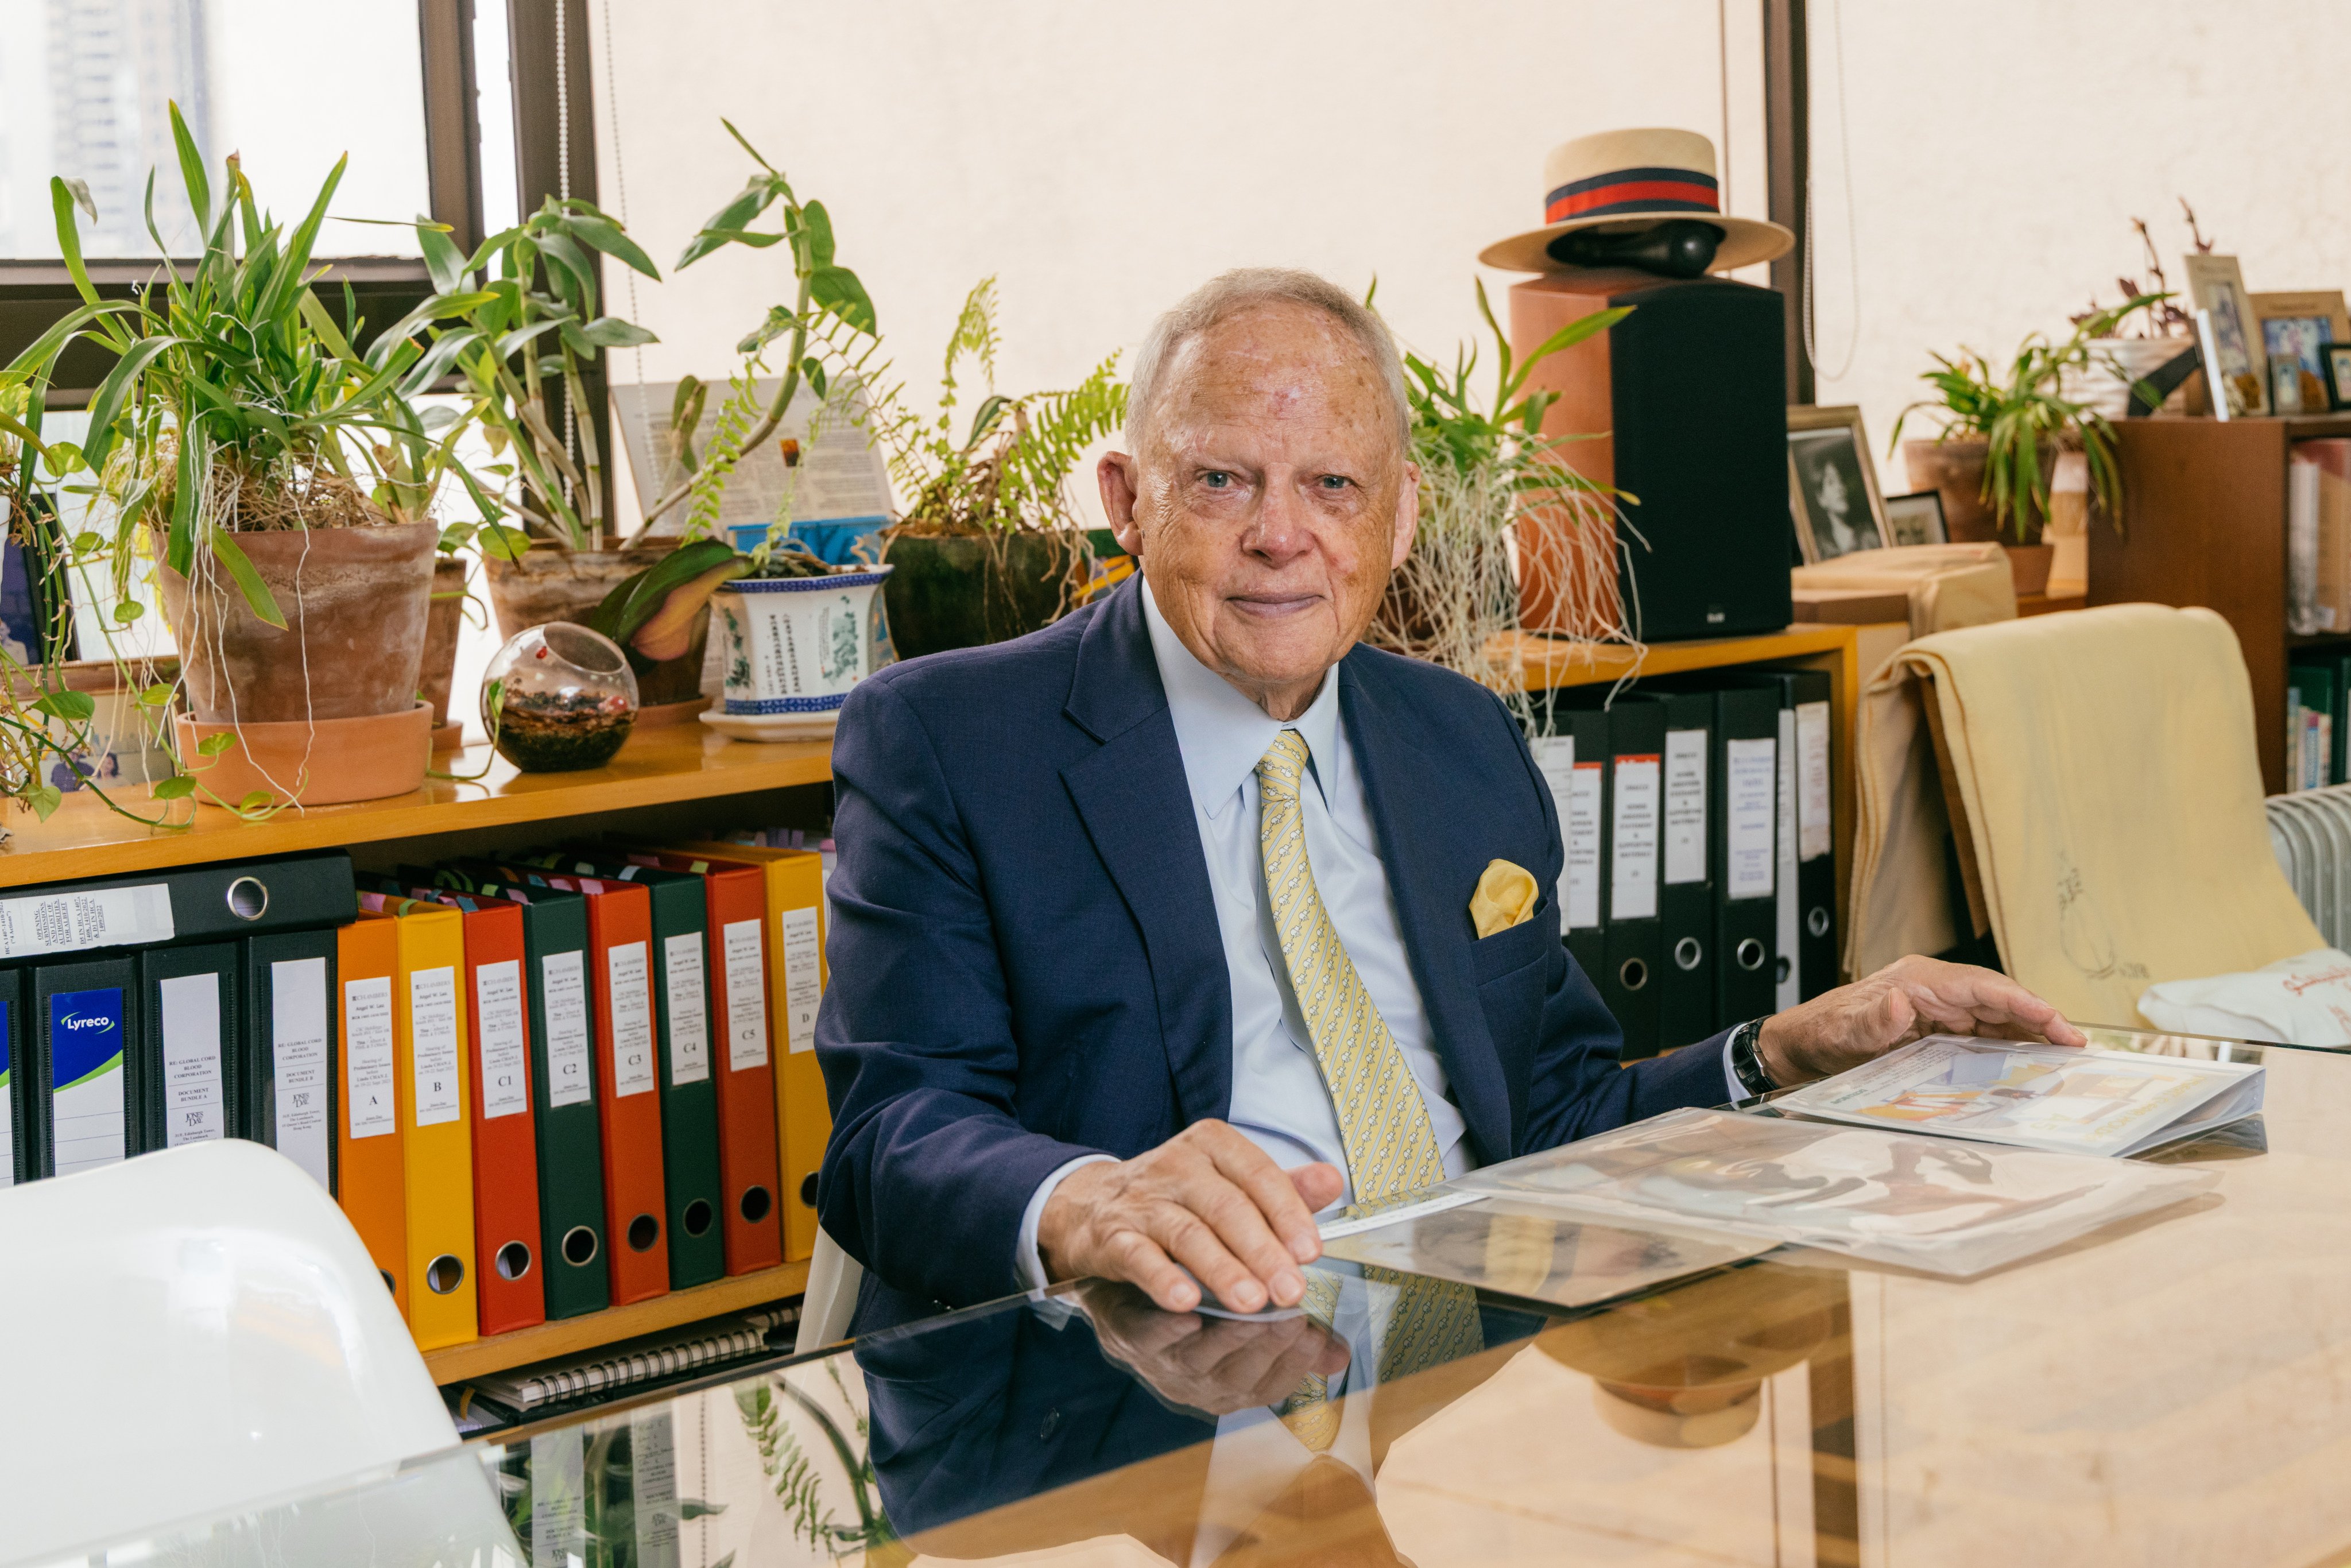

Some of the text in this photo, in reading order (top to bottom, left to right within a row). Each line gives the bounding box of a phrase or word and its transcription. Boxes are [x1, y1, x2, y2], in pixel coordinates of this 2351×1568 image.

[47, 904, 53, 912] OF
[82, 899, 90, 926] 1410/2022
[61, 903, 69, 927] ALBERT
[96, 905, 106, 931] 1409/2022
[34, 911, 43, 940] OPENING
[41, 902, 51, 946] SUBMISSIONS
[54, 900, 65, 945] AUTHORITIES
[67, 1016, 109, 1031] Lyreco
[802, 1013, 810, 1023] D
[742, 1029, 755, 1040] C5
[684, 1043, 696, 1053] C4
[282, 1052, 318, 1060] CORPORATION
[629, 1054, 641, 1066] C3
[286, 1070, 315, 1078] DOCUMENT
[563, 1063, 577, 1074] C2
[174, 1070, 212, 1079] CORPORATION
[434, 1082, 441, 1091] B
[498, 1075, 511, 1087] C1
[179, 1087, 209, 1096] DOCUMENT
[292, 1093, 309, 1103] JONES
[369, 1095, 378, 1105] A
[185, 1111, 204, 1122] JONES
[189, 1117, 203, 1126] DAY
